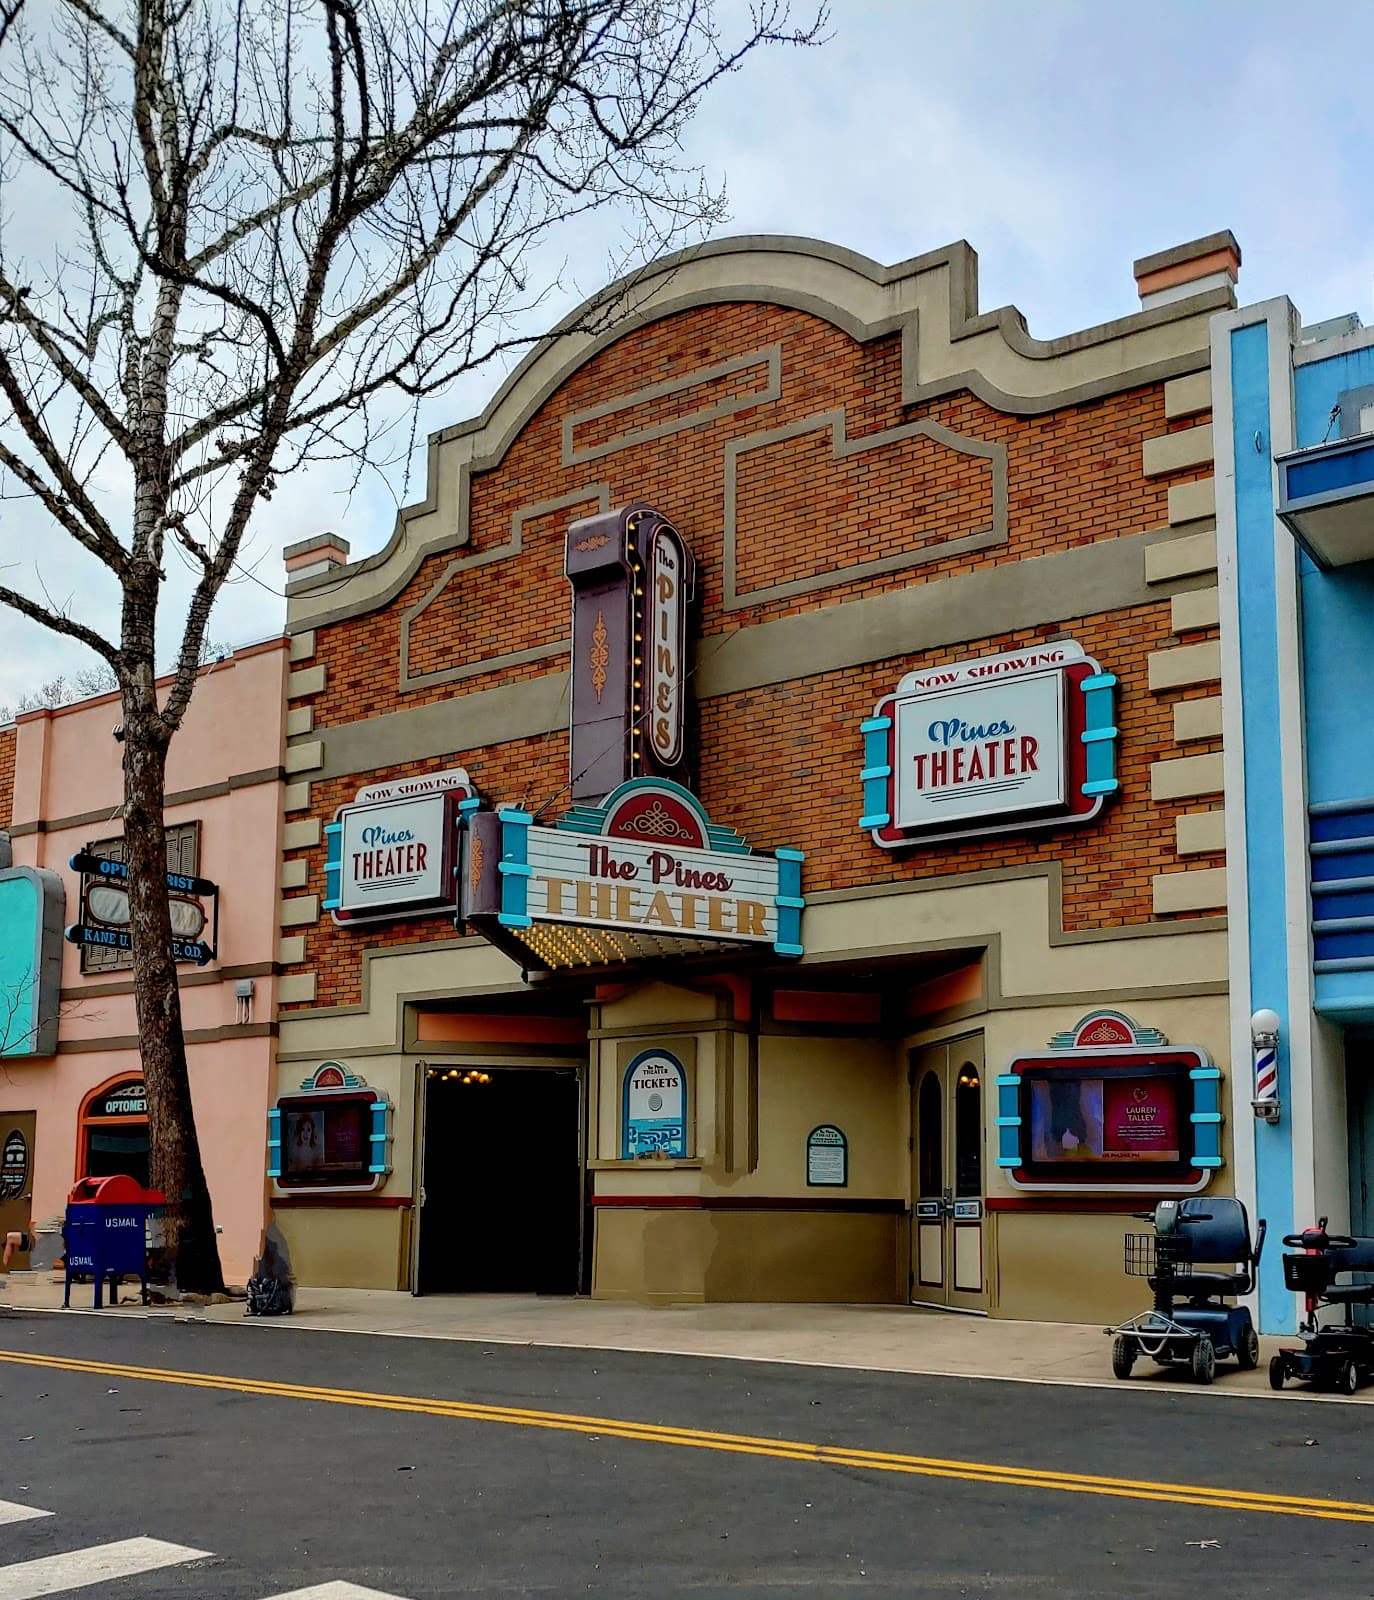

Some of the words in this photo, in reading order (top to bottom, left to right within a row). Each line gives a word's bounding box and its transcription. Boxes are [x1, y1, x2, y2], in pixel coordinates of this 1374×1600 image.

[656, 540, 675, 569] The
[914, 671, 959, 690] NOW
[967, 650, 1064, 678] SHOWING
[928, 718, 1016, 746] Pines
[913, 735, 1039, 790] THEATER
[365, 788, 393, 800] NOW
[398, 776, 457, 794] SHOWING
[362, 826, 414, 847] Pines
[100, 861, 194, 890] OPTRIST
[352, 843, 427, 880] THEATER
[577, 843, 639, 881] The
[646, 850, 733, 892] Pines
[536, 875, 768, 936] THEATER
[84, 928, 116, 944] KANE
[633, 1077, 678, 1089] TICKETS
[105, 1099, 148, 1113] OPTOMET
[1126, 1106, 1156, 1114] LAUREN
[1127, 1114, 1155, 1122] TALLEY
